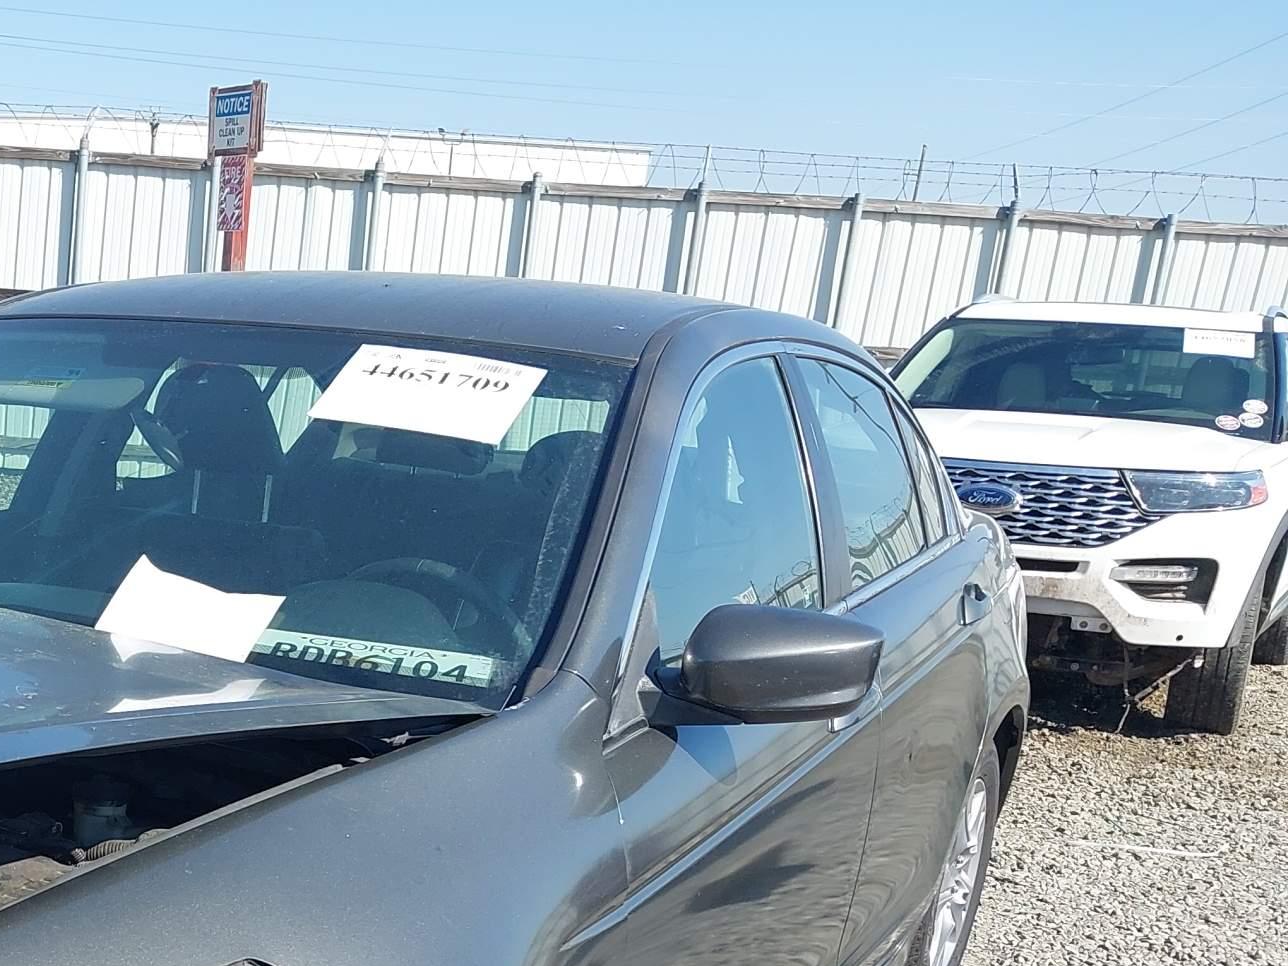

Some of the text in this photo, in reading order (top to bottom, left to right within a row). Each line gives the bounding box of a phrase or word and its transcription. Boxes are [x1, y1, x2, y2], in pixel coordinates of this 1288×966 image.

[217, 96, 250, 114] NOTICE
[225, 117, 239, 127] SPILL
[218, 126, 244, 137] CLEAN UP
[226, 138, 235, 146] KIT
[224, 166, 242, 178] FIRE
[361, 362, 510, 393] 44651709
[968, 490, 1004, 504] Ford
[308, 636, 435, 660] GEORGIA
